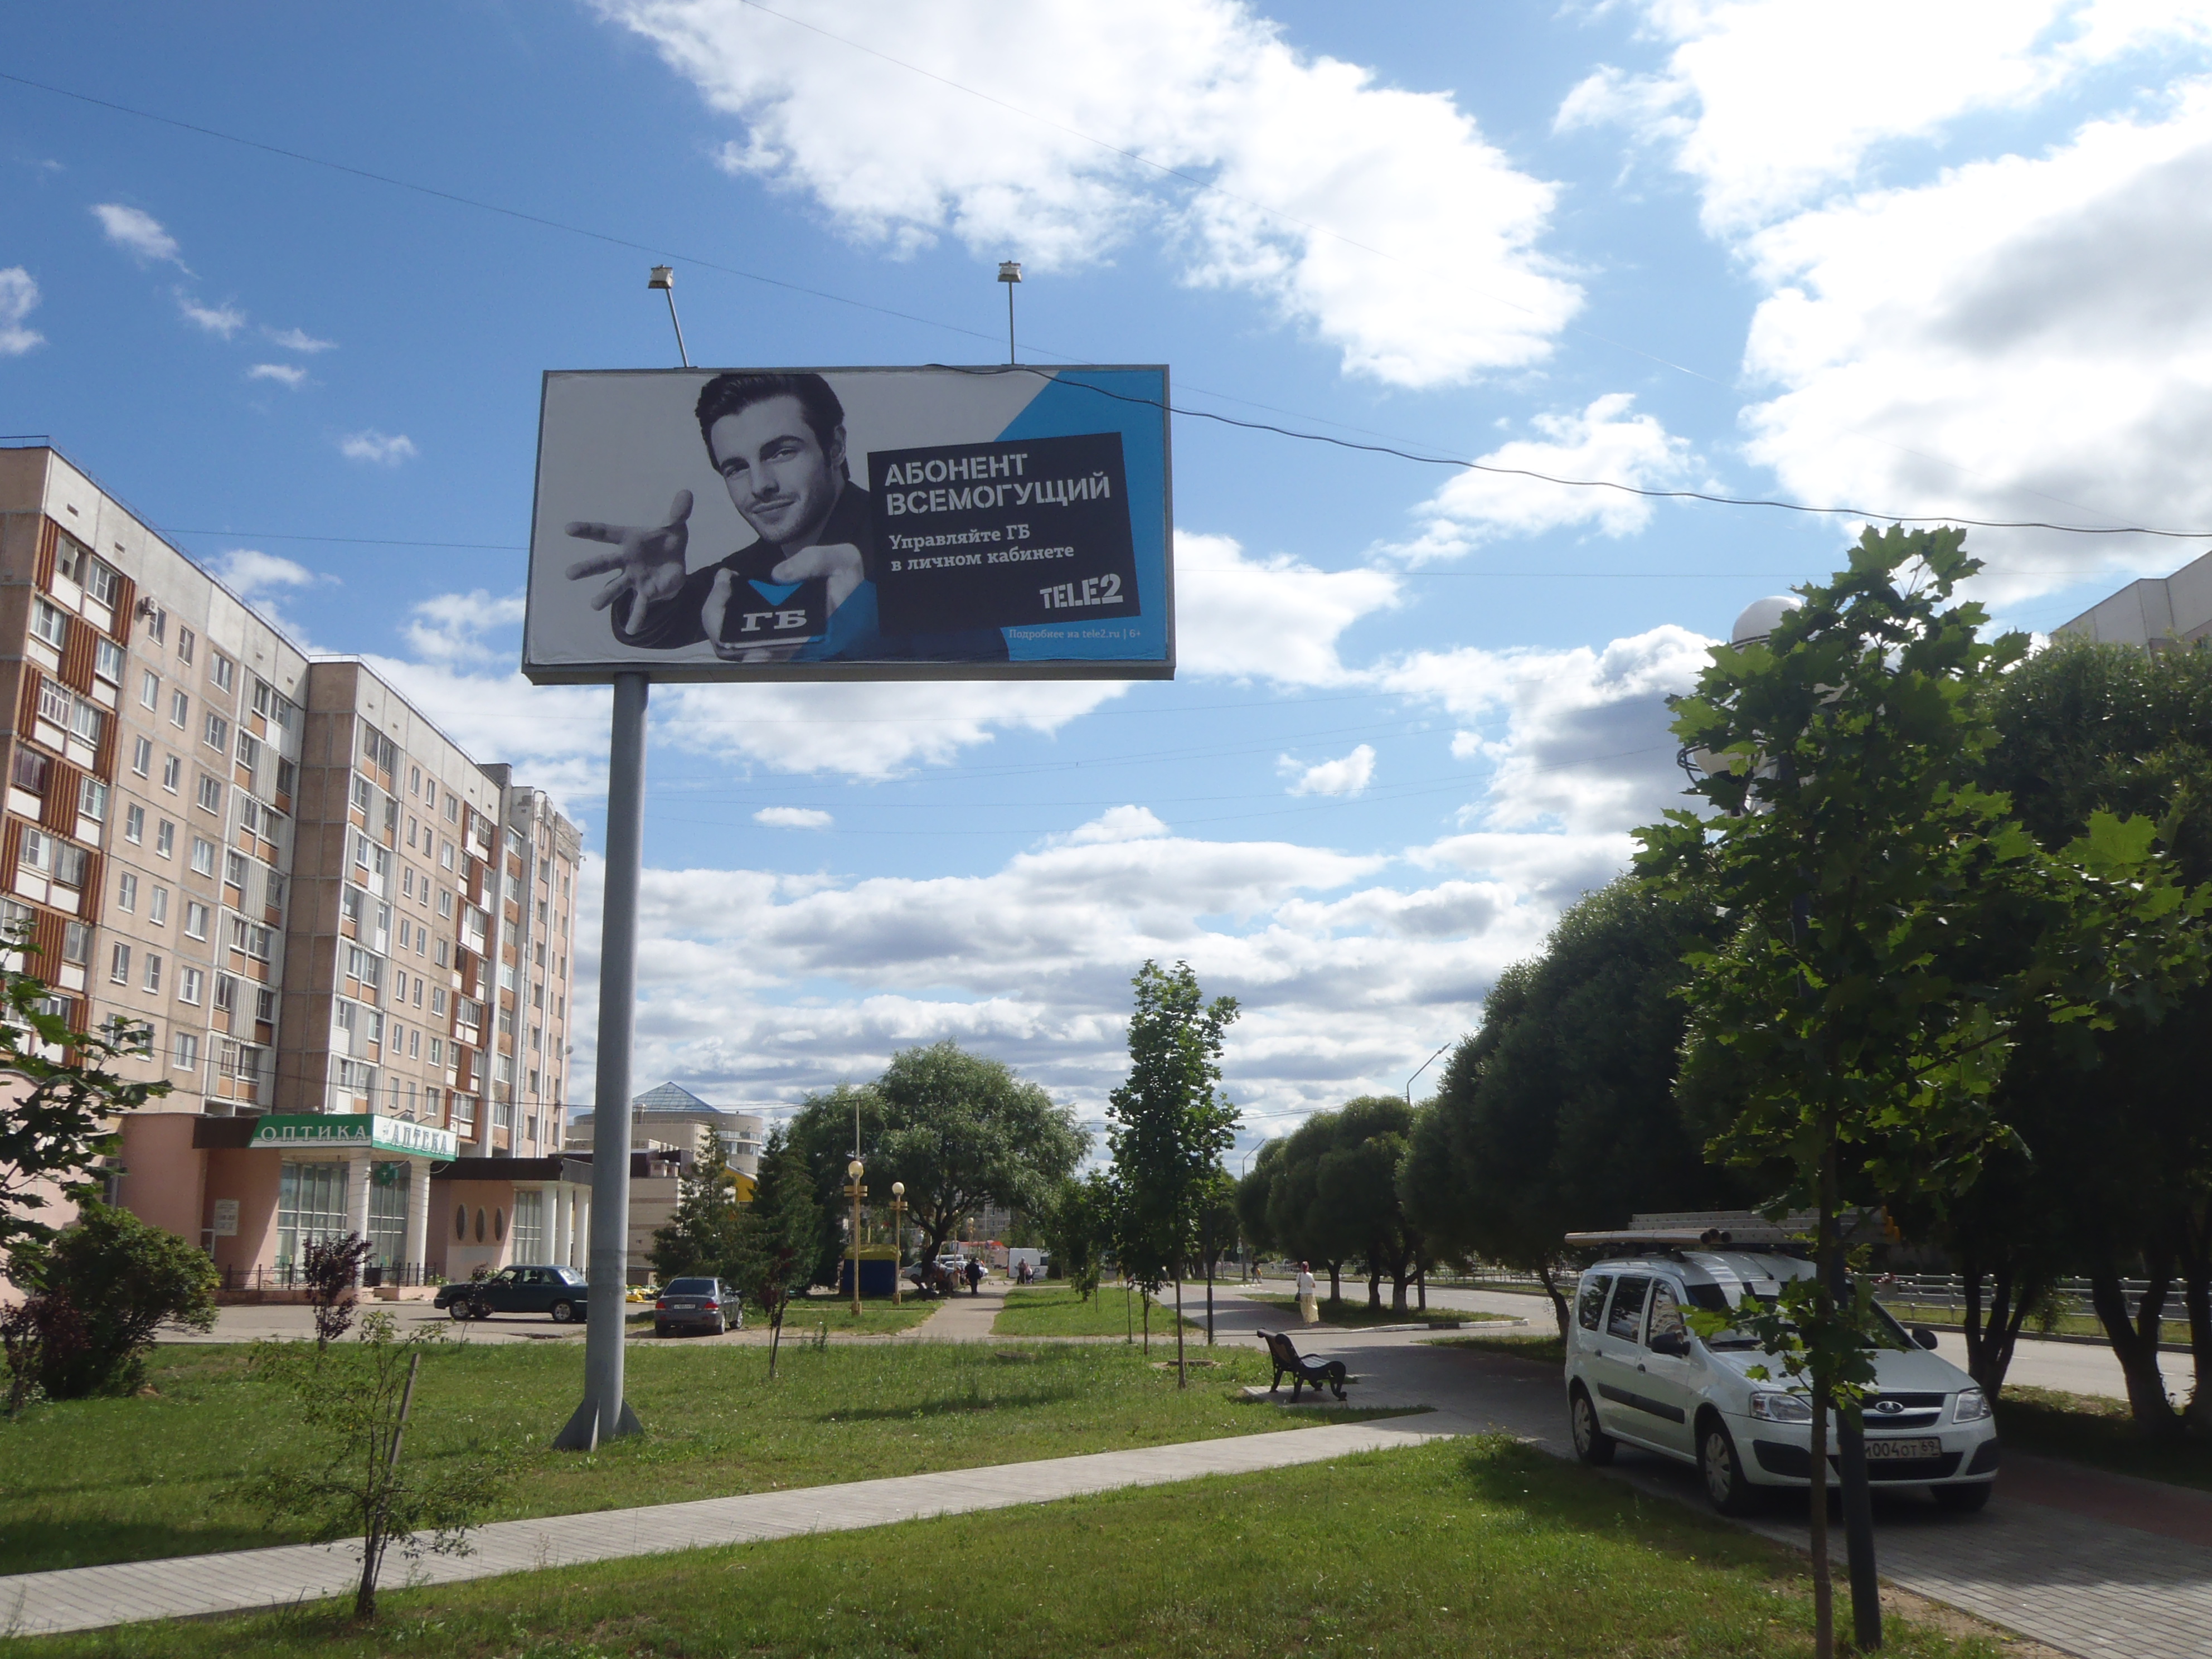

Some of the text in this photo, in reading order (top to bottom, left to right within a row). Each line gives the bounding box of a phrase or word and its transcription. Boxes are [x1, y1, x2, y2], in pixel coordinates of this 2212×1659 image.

[885, 453, 1028, 487] АБОНЕНТ
[886, 471, 1110, 516] ВСЕМОГУЩИЙ
[889, 523, 1031, 552] Управляйте ГБ
[891, 546, 1075, 572] в личном кабинете
[1039, 573, 1124, 609] TELE2
[740, 609, 808, 632] ГБ
[1009, 629, 1064, 641] Подробнее
[1083, 629, 1120, 638] tele2.ru
[1129, 629, 1141, 638] 6+
[260, 1125, 367, 1142] ОПТИКА
[391, 1123, 448, 1156] АПТЕКА
